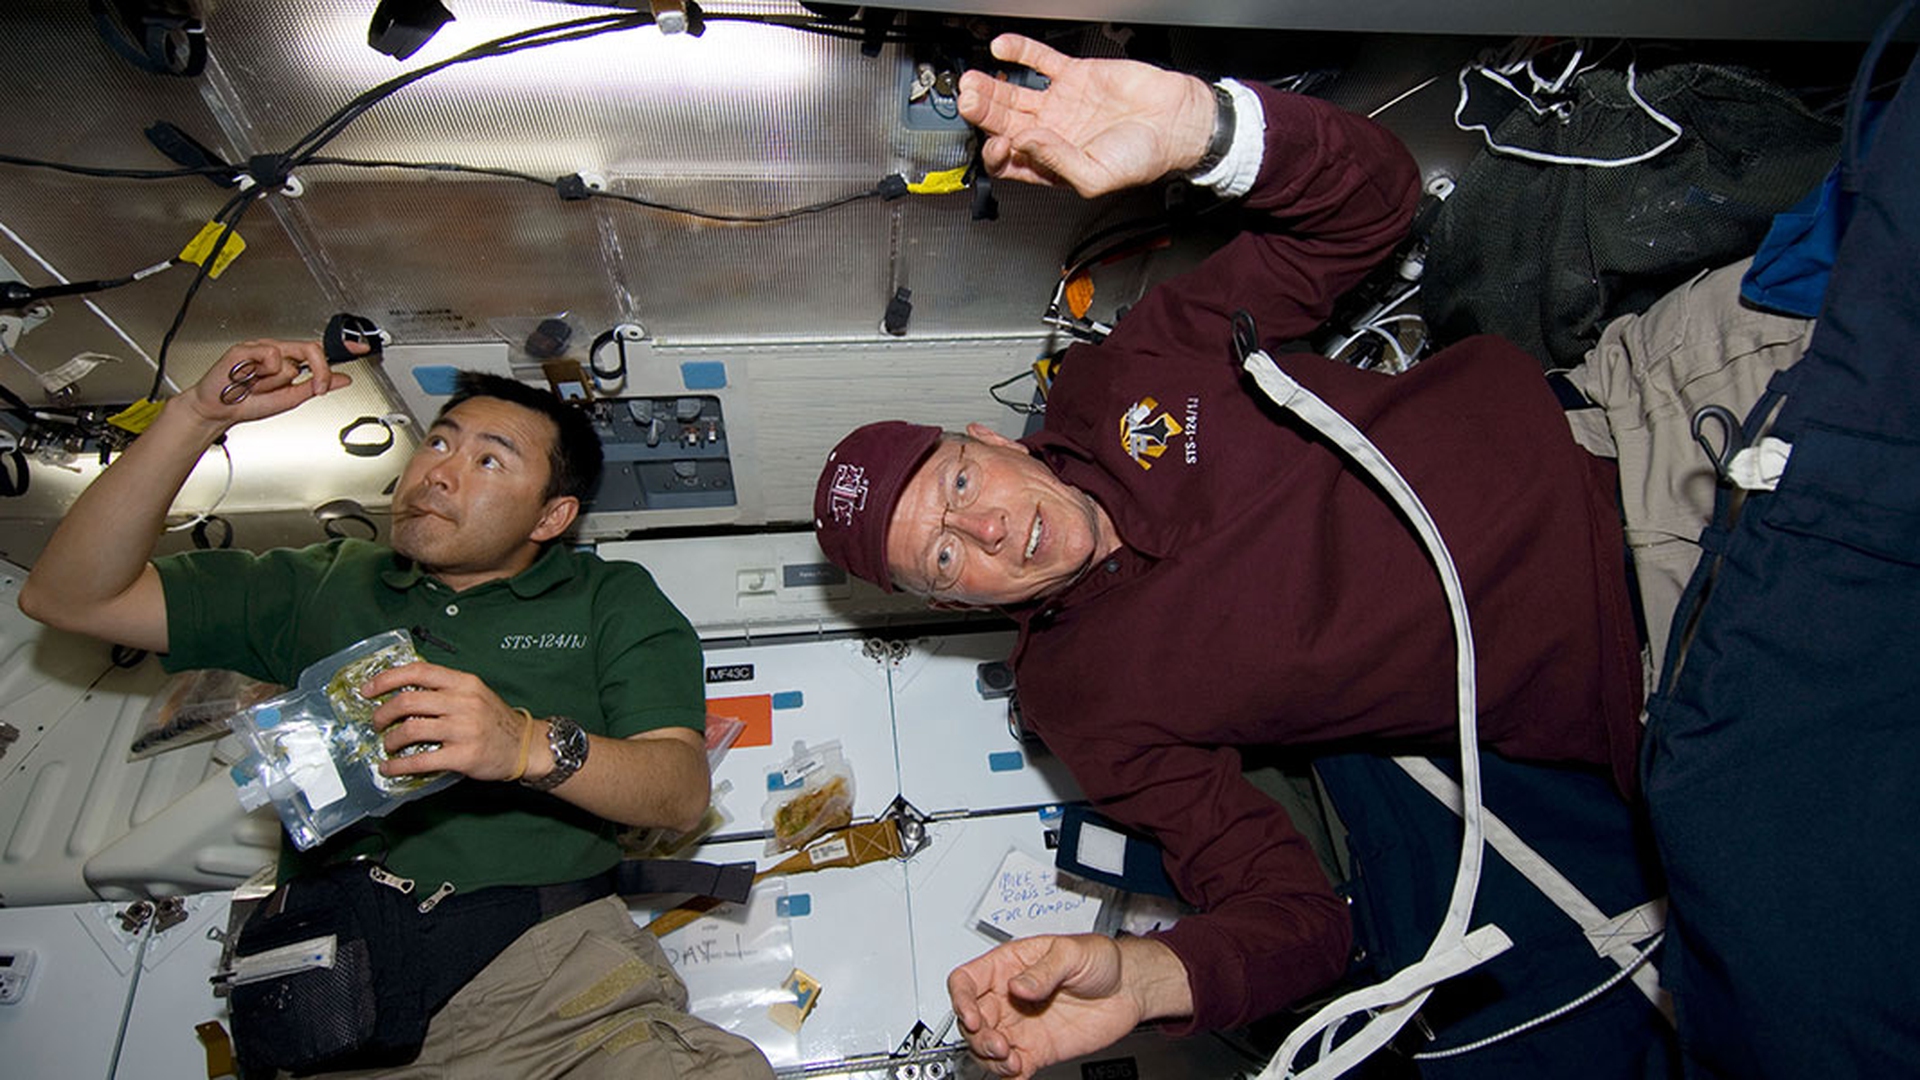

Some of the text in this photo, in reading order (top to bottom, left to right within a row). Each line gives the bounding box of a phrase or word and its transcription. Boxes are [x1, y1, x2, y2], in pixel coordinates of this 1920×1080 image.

[1184, 398, 1199, 464] STS-124/1J
[500, 633, 588, 649] STS-124/1J
[710, 667, 750, 680] MF43C
